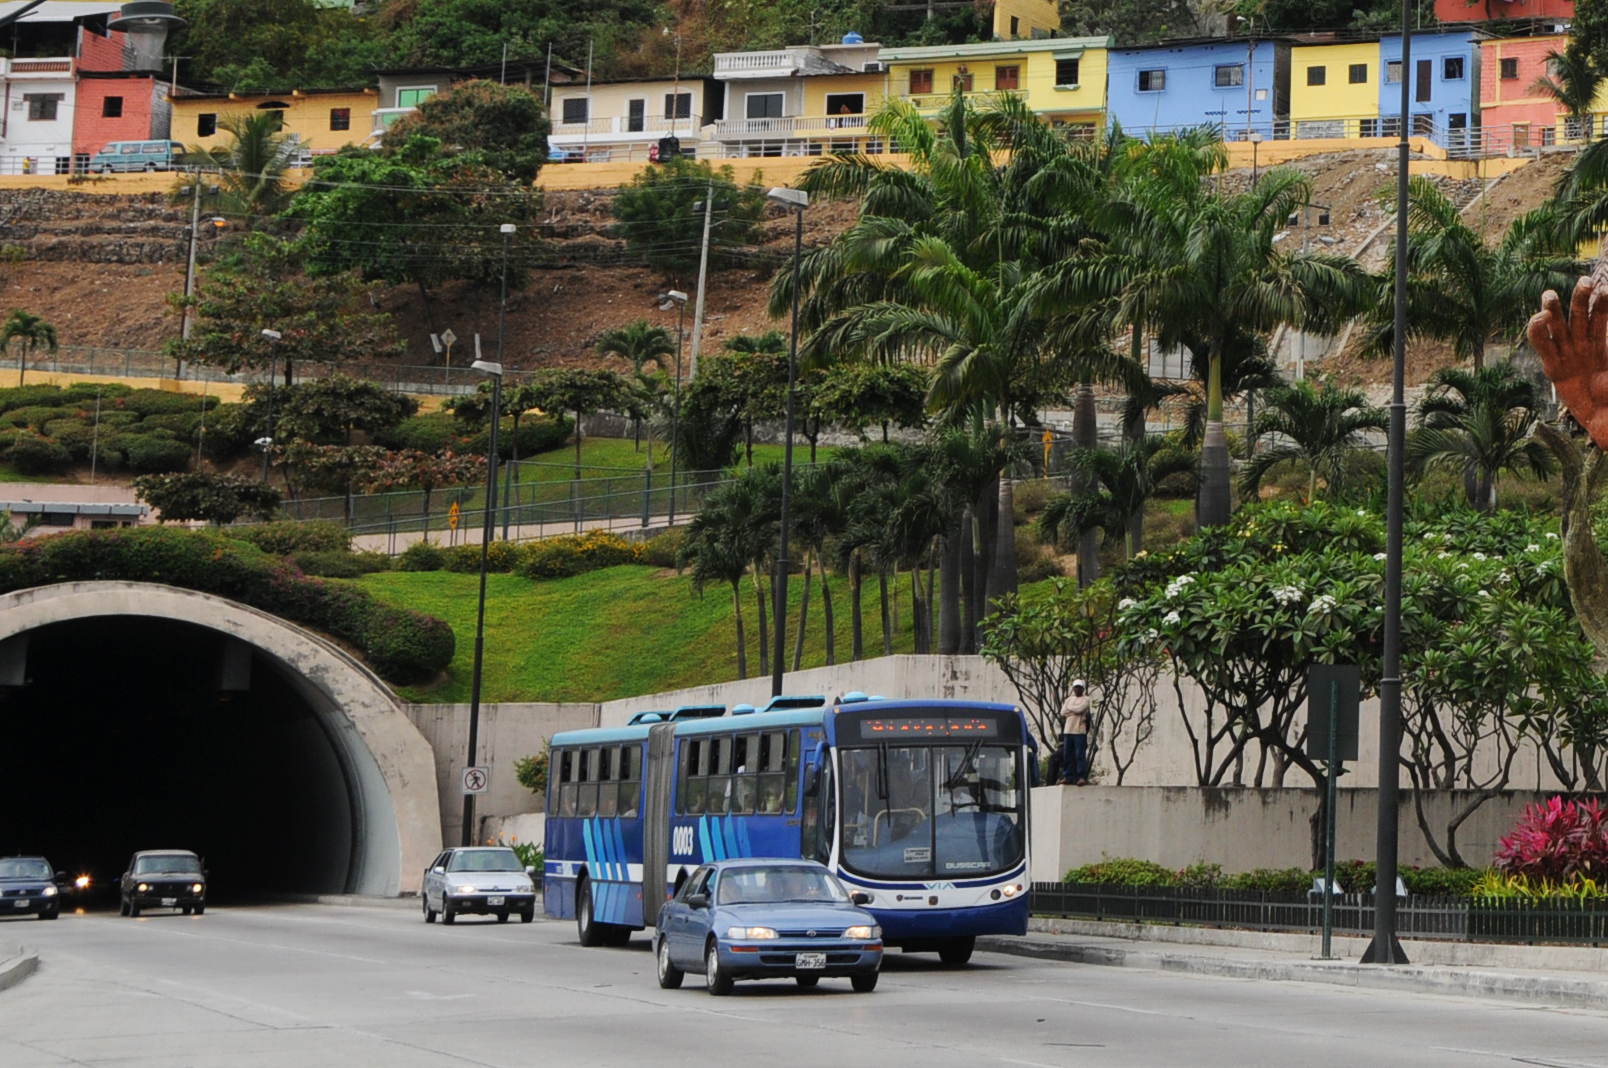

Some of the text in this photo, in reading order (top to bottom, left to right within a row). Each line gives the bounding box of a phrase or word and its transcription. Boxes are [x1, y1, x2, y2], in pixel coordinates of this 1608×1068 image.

[673, 825, 694, 856] 0003
[945, 861, 991, 869] BUSSCAR
[925, 882, 954, 890] VIA
